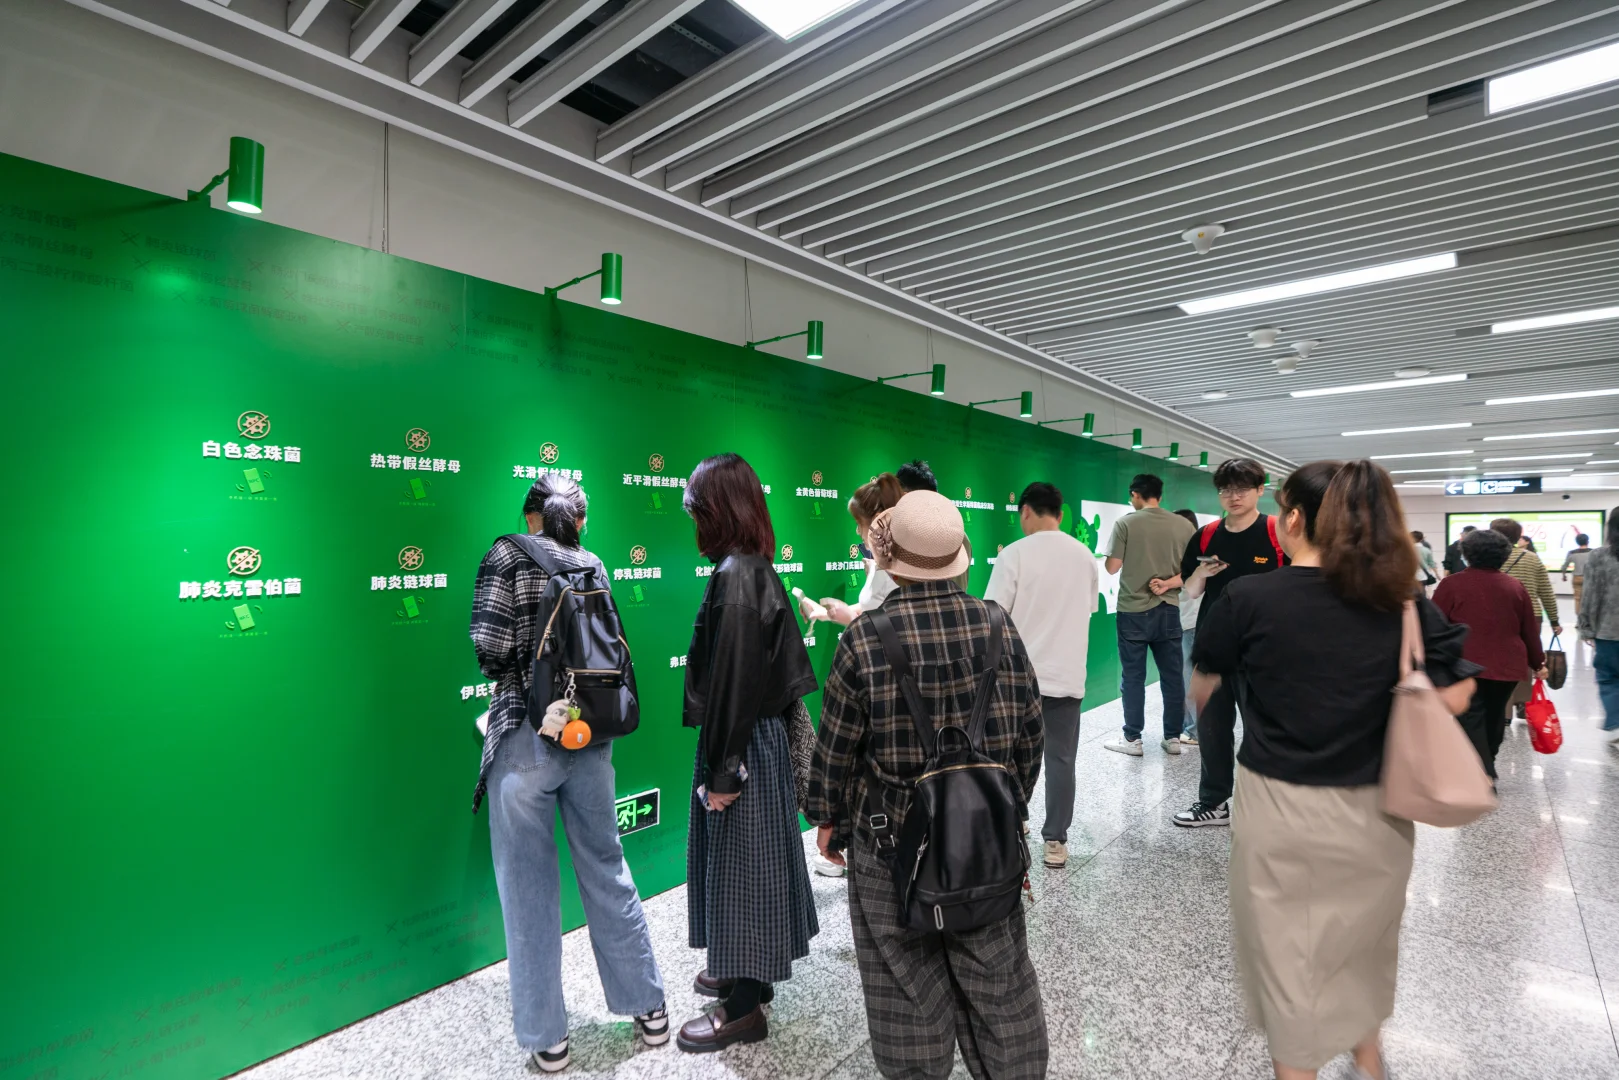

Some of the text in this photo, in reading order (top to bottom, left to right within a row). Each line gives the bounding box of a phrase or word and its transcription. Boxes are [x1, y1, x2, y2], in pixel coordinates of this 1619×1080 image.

[202, 440, 301, 462] 白色念珠菌
[370, 453, 461, 473] 热带假丝酵母
[623, 473, 687, 489] 近平滑假丝酵母
[796, 487, 838, 499] 金黄色葡萄球菌
[370, 573, 448, 591] 肺炎链球菌
[613, 567, 662, 580] 停乳链球菌
[179, 578, 302, 600] 肺炎克雷伯菌
